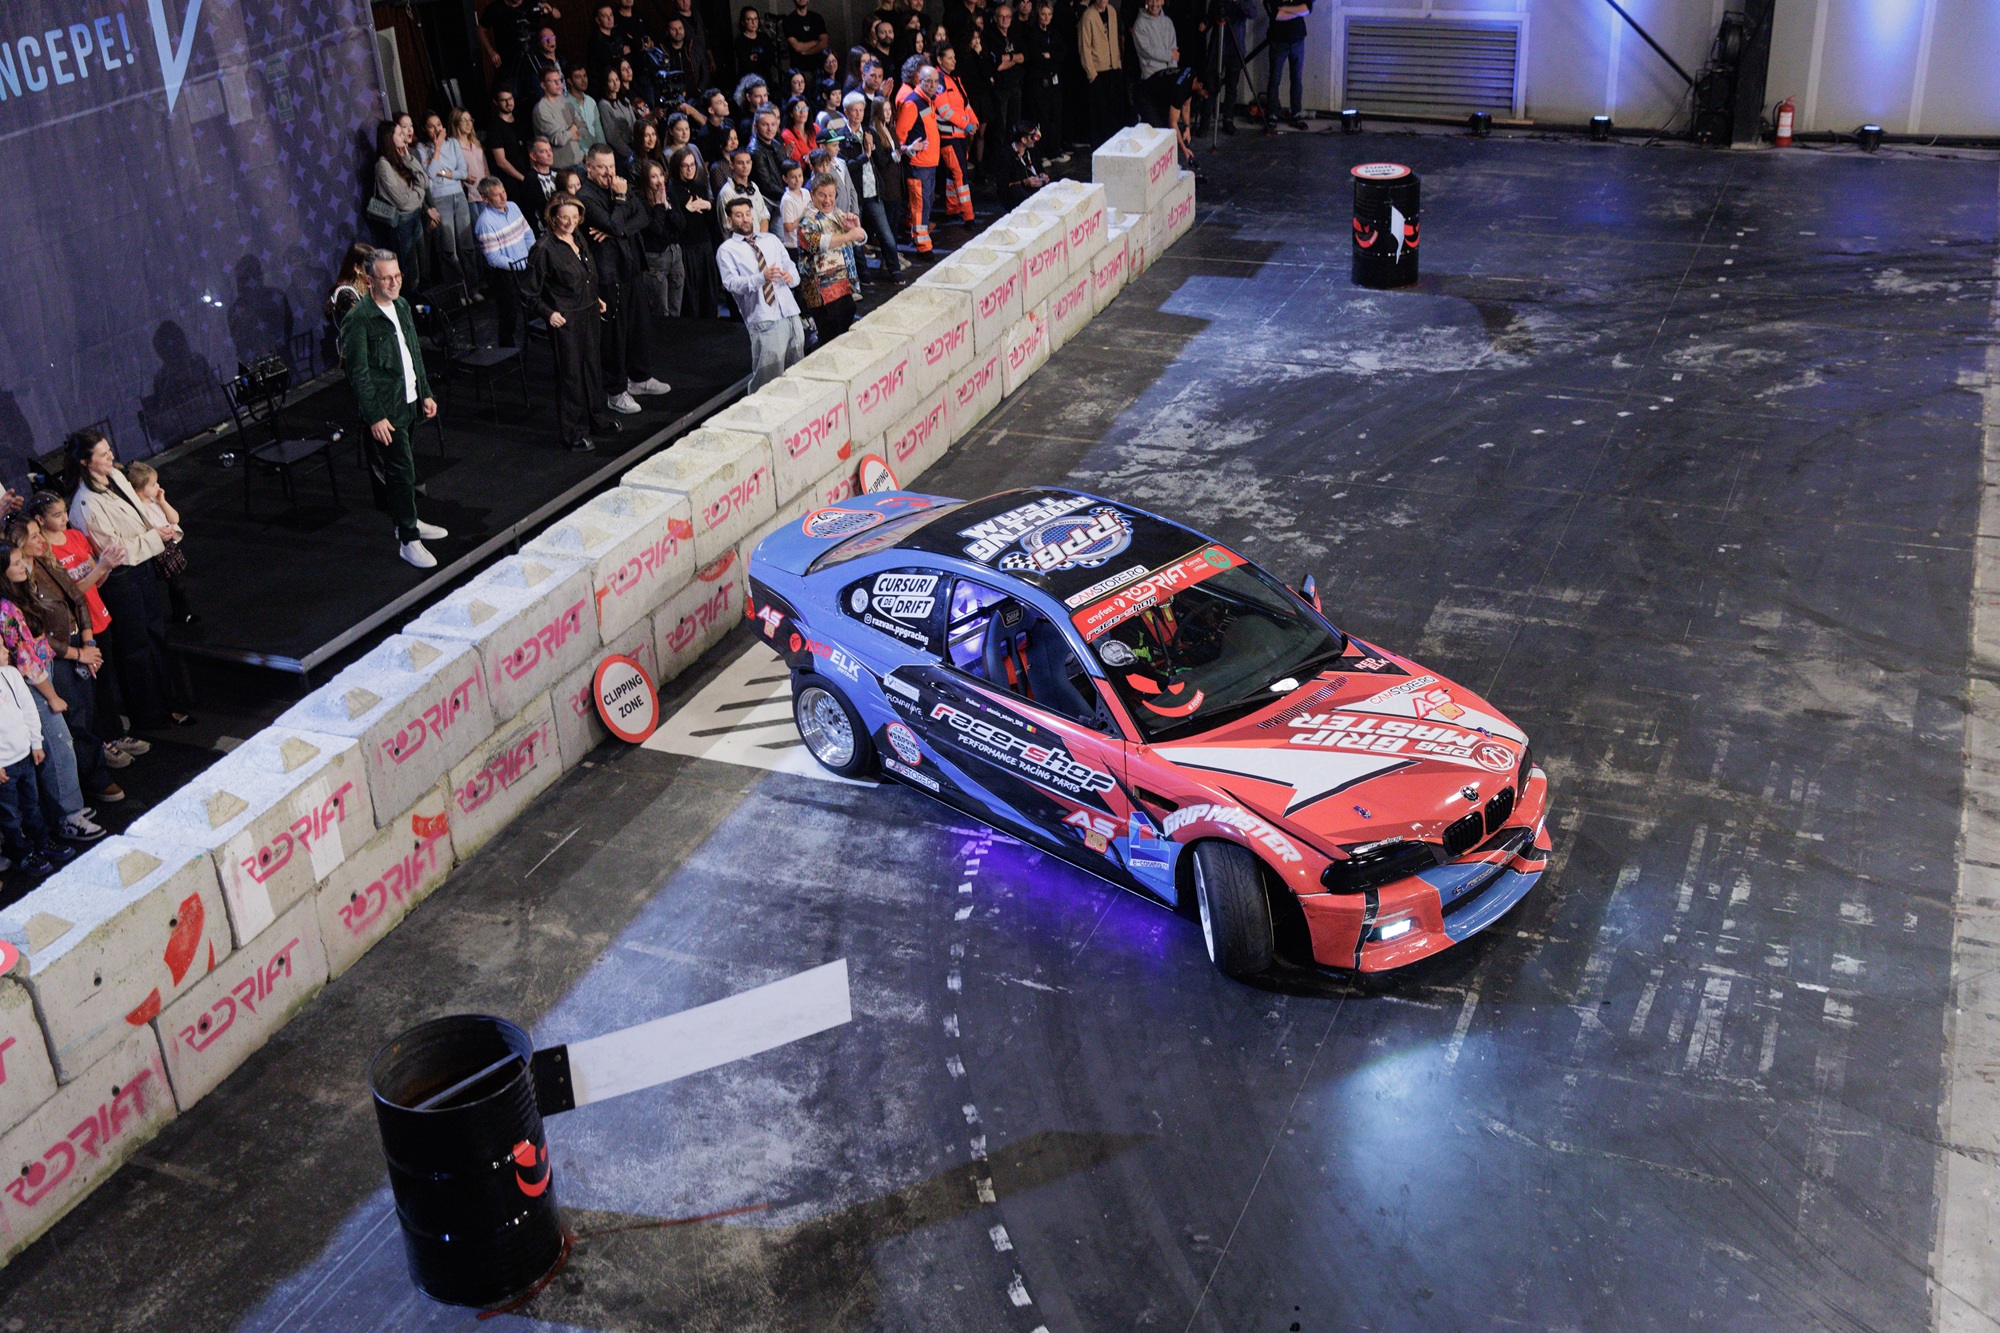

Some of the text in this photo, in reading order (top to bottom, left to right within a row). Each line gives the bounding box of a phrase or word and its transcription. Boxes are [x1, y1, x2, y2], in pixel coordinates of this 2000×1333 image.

[959, 498, 1057, 538] TEAM
[963, 497, 1100, 562] RACING
[1032, 511, 1126, 571] PPG
[1208, 554, 1227, 565] 96
[877, 577, 933, 593] CURSURI
[884, 598, 893, 607] DE
[894, 600, 931, 614] DRIFT
[1086, 605, 1116, 626] anyfast
[871, 617, 930, 646] razvan.ppgracing
[1354, 657, 1377, 670] RED
[1368, 658, 1390, 671] ELK
[603, 673, 643, 706] CLIPPING
[1413, 687, 1454, 720] AS
[618, 696, 644, 718] ZONE
[1287, 711, 1480, 749] MASTER
[1288, 729, 1475, 758] PPG GRIP
[957, 733, 1081, 794] PERFORMANCE RACING PARTS
[1066, 810, 1118, 839] AS
[1086, 828, 1108, 852] 96
